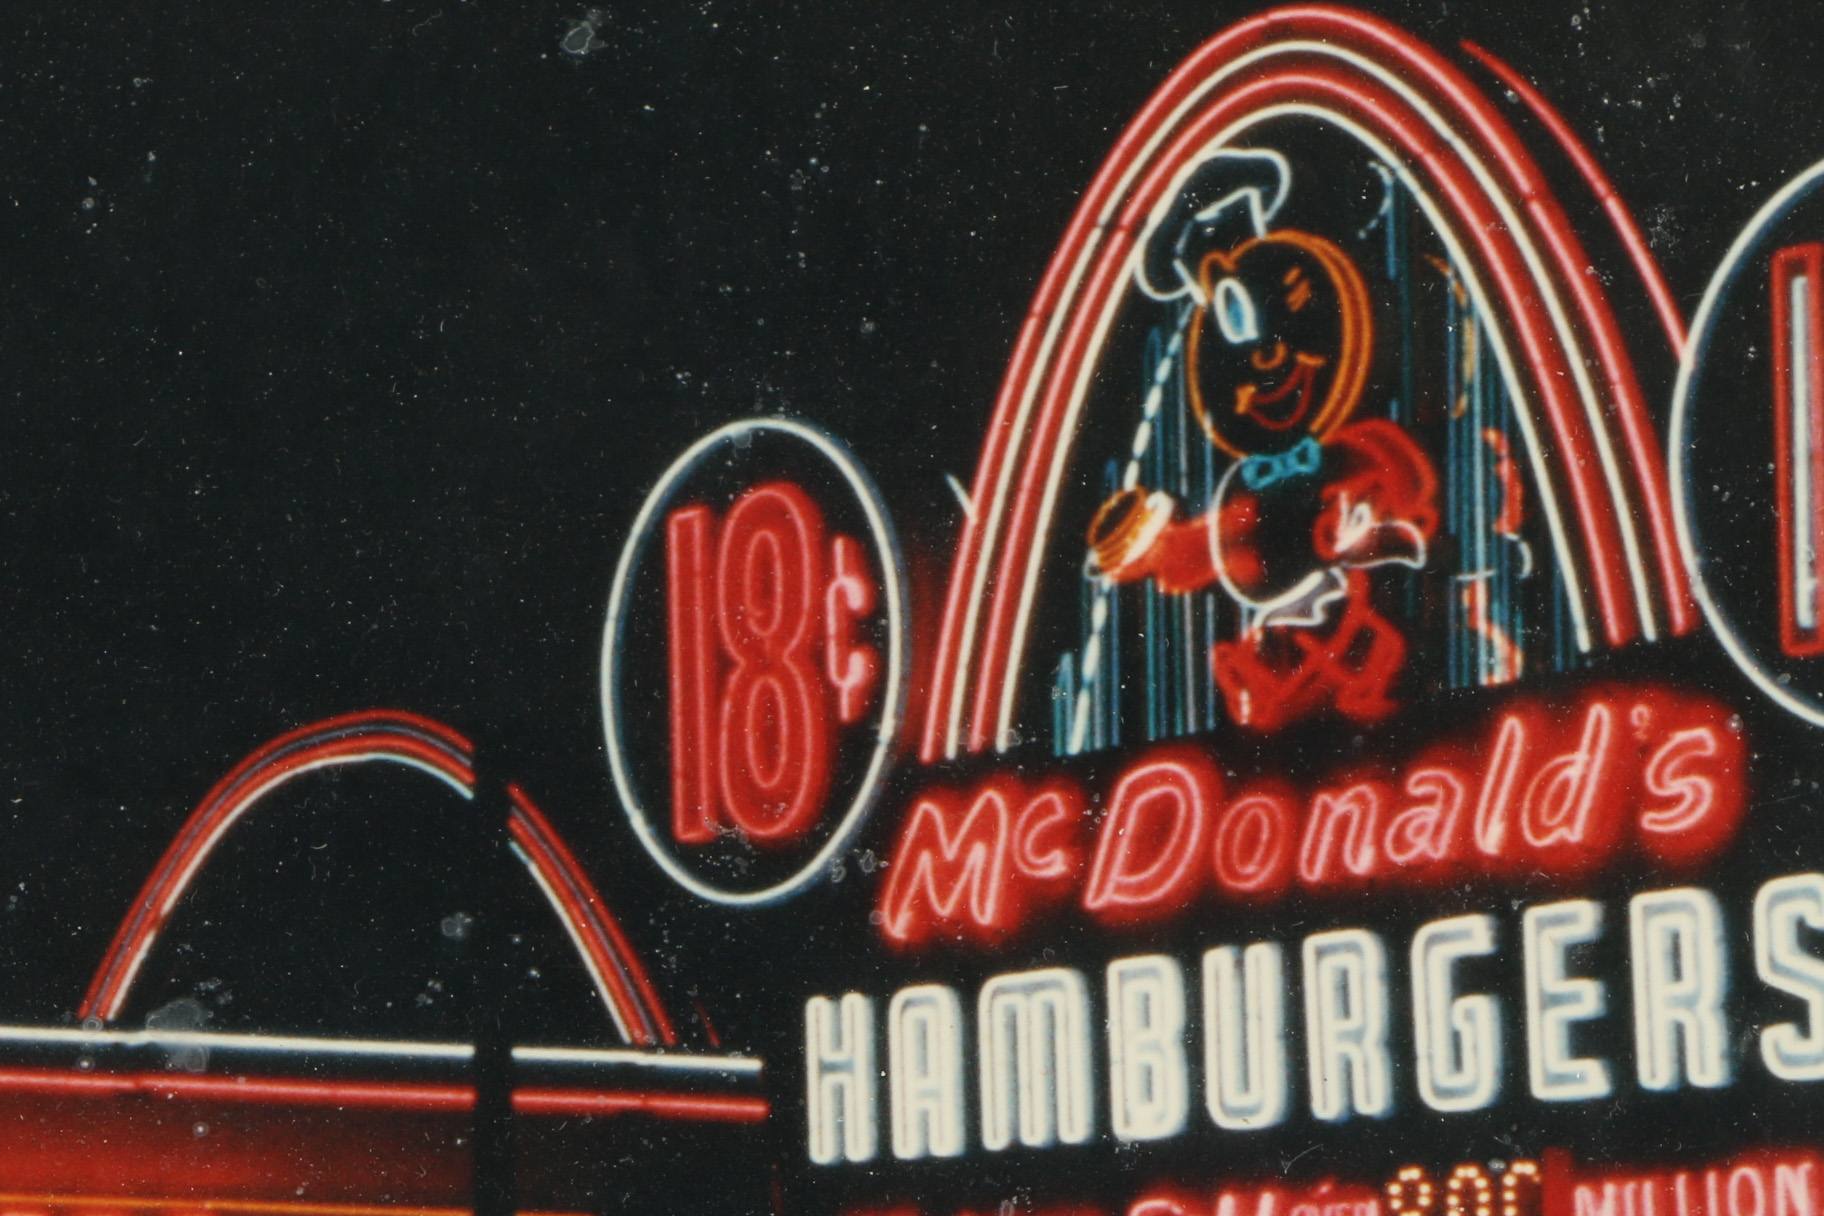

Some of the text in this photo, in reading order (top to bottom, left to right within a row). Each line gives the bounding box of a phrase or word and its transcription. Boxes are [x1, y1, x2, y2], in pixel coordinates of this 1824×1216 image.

[668, 485, 868, 839] 18¢
[880, 702, 1718, 940] McDonald's
[805, 872, 1824, 1165] HAMBURGERS
